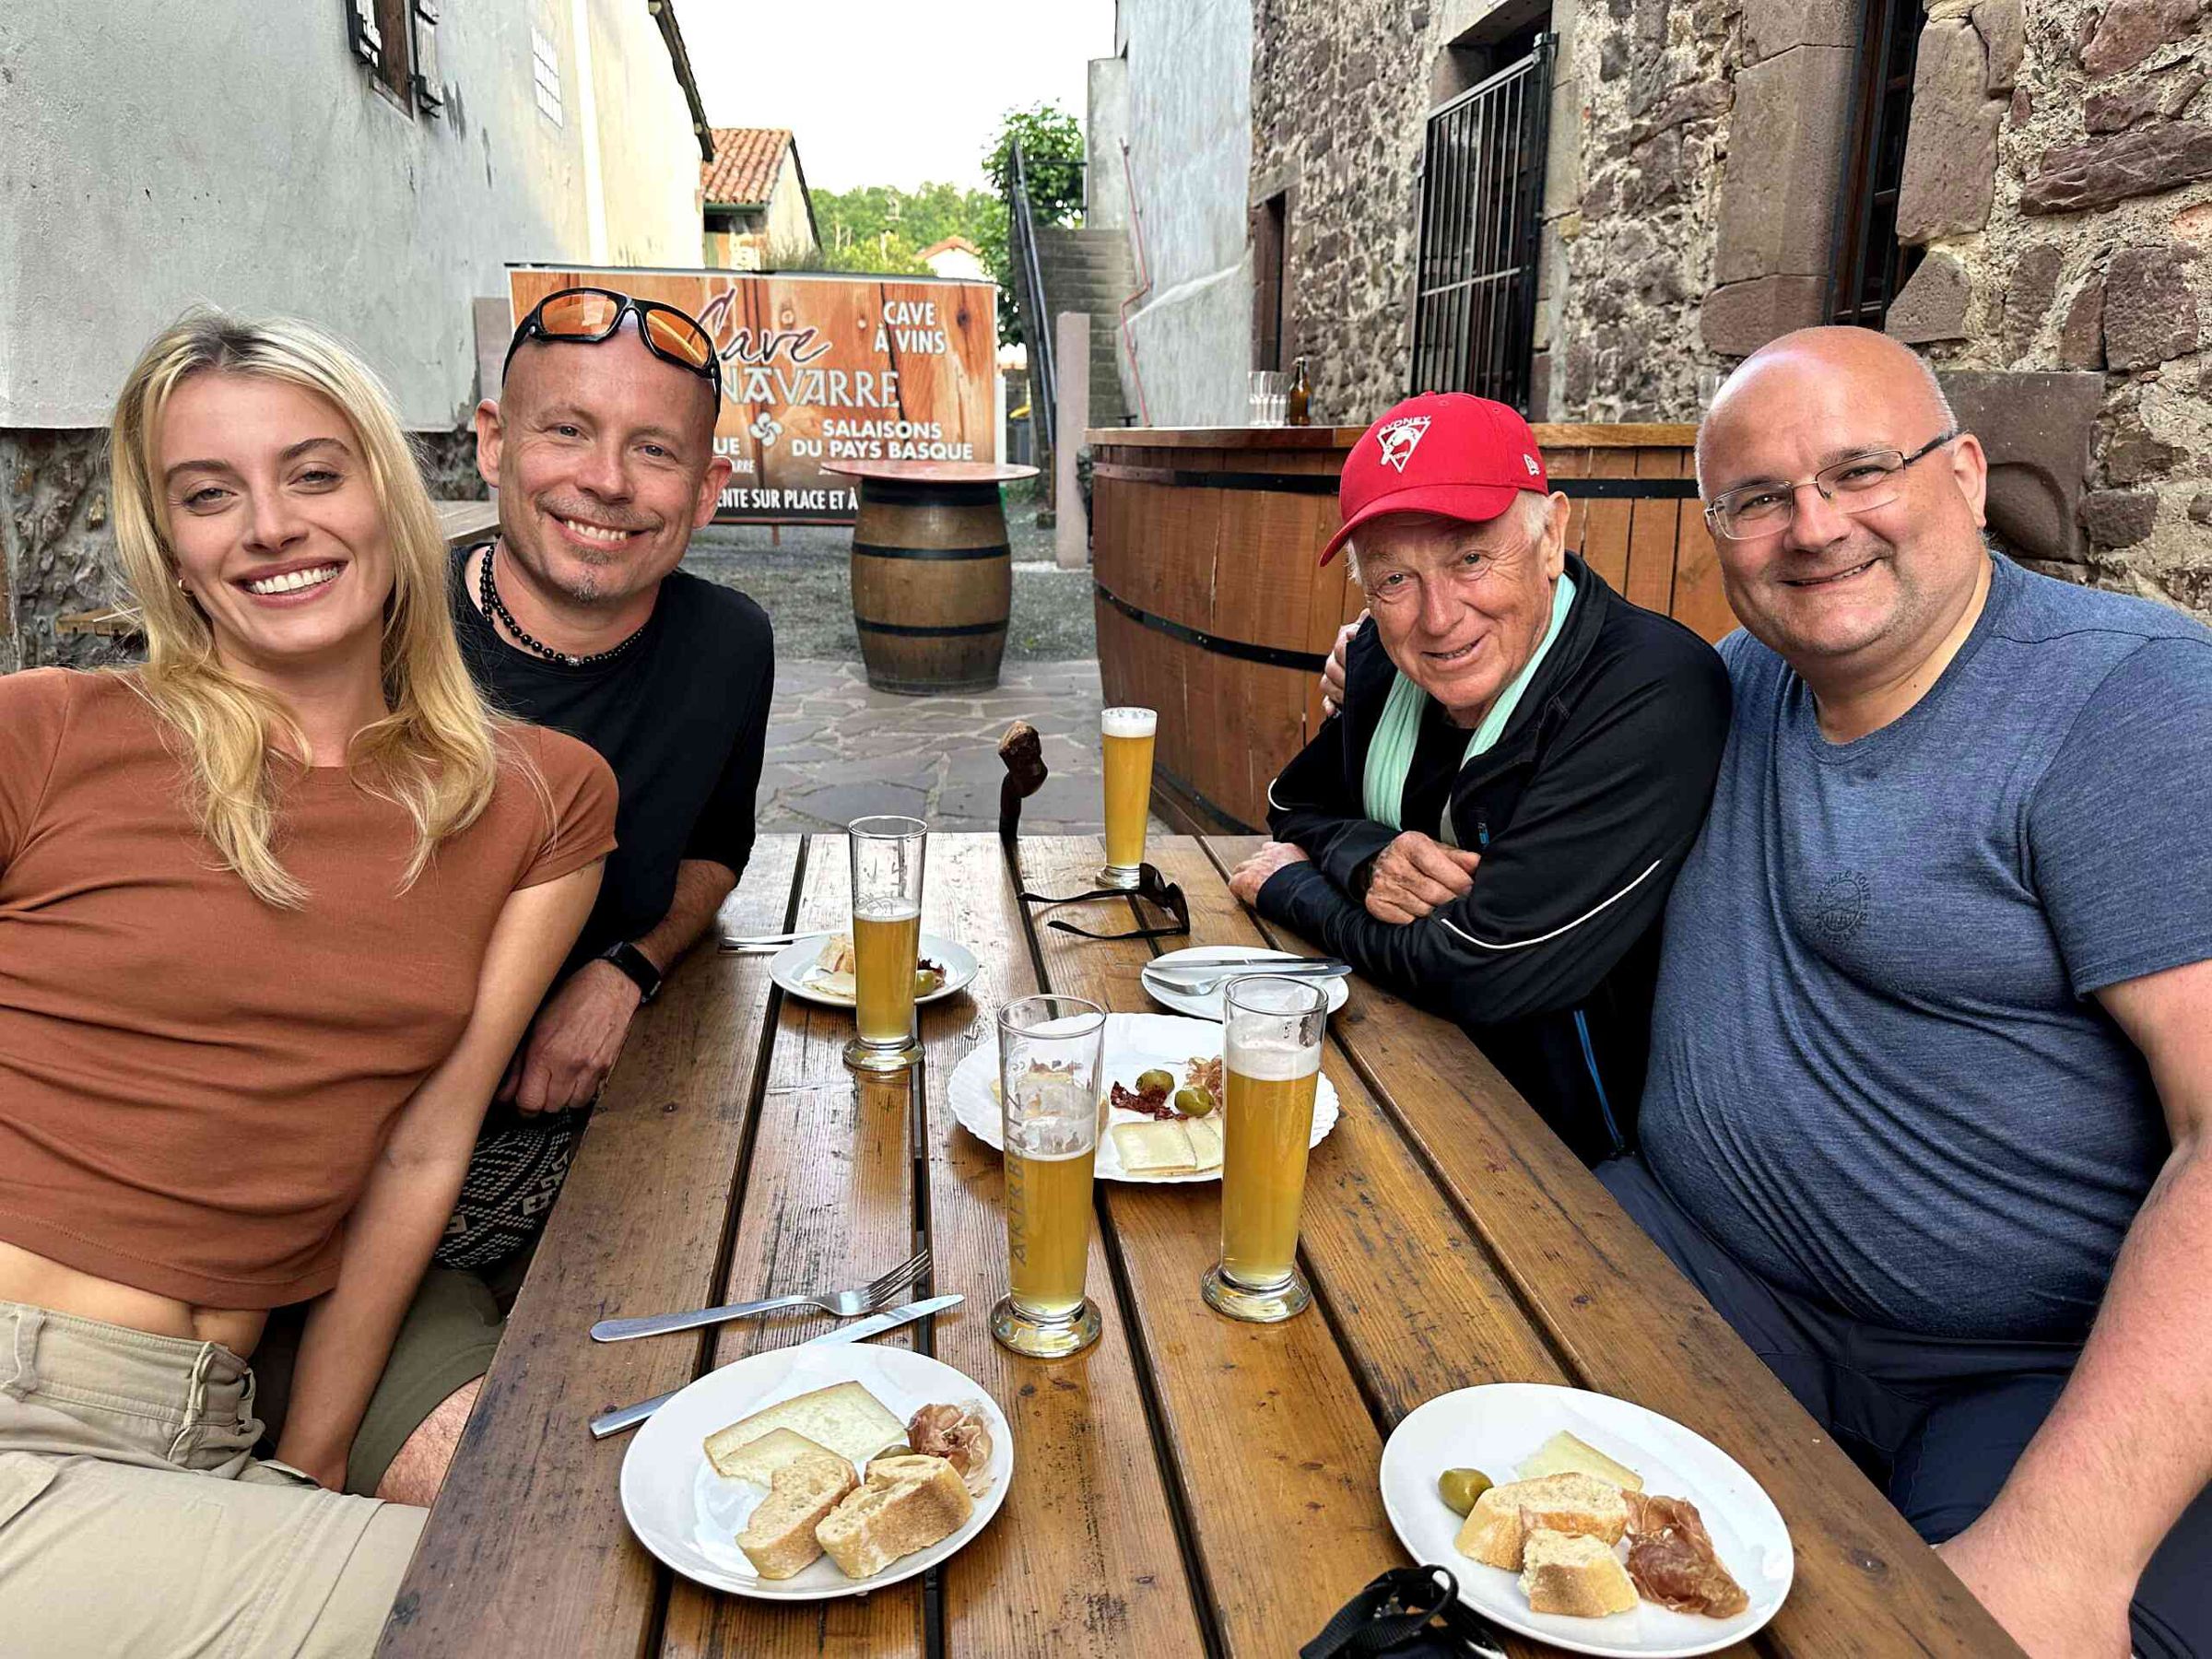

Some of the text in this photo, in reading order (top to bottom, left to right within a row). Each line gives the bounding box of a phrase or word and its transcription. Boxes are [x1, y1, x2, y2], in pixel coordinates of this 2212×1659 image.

[883, 301, 935, 326] CAVE
[875, 324, 947, 355] À VINS
[722, 367, 900, 408] NAVARRE
[822, 419, 942, 440] SALAISONS
[713, 436, 740, 455] UE
[792, 439, 973, 461] DU PAYS BASQUE
[718, 486, 859, 511] NTE SUR PLACE ET À
